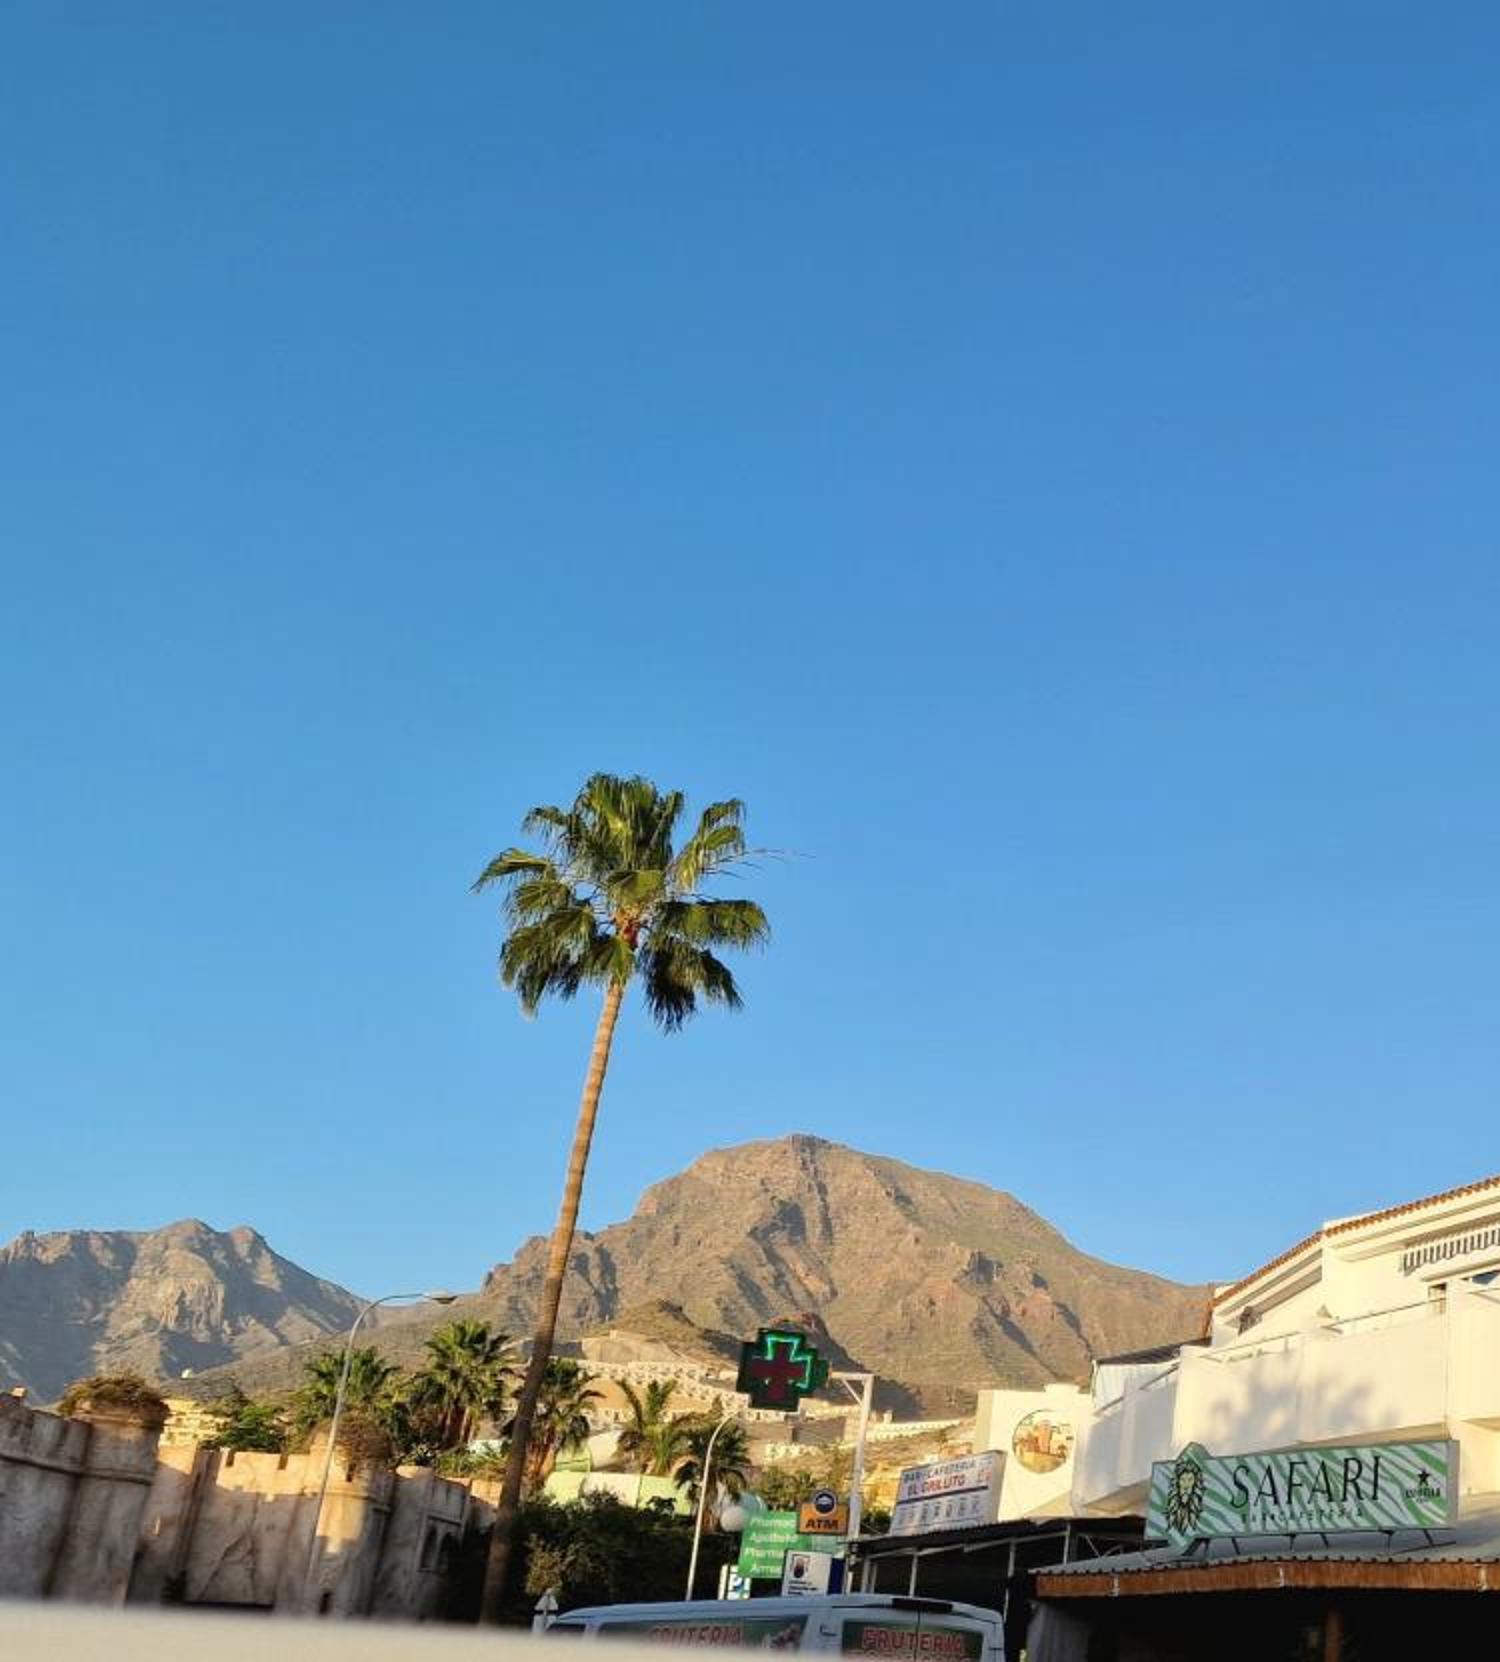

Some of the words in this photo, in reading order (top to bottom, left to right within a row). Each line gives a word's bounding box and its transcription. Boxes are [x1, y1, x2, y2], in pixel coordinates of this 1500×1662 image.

[1230, 1455, 1381, 1509] SAFARI
[806, 1518, 839, 1530] ATM
[863, 1627, 962, 1653] FRUTERIA
